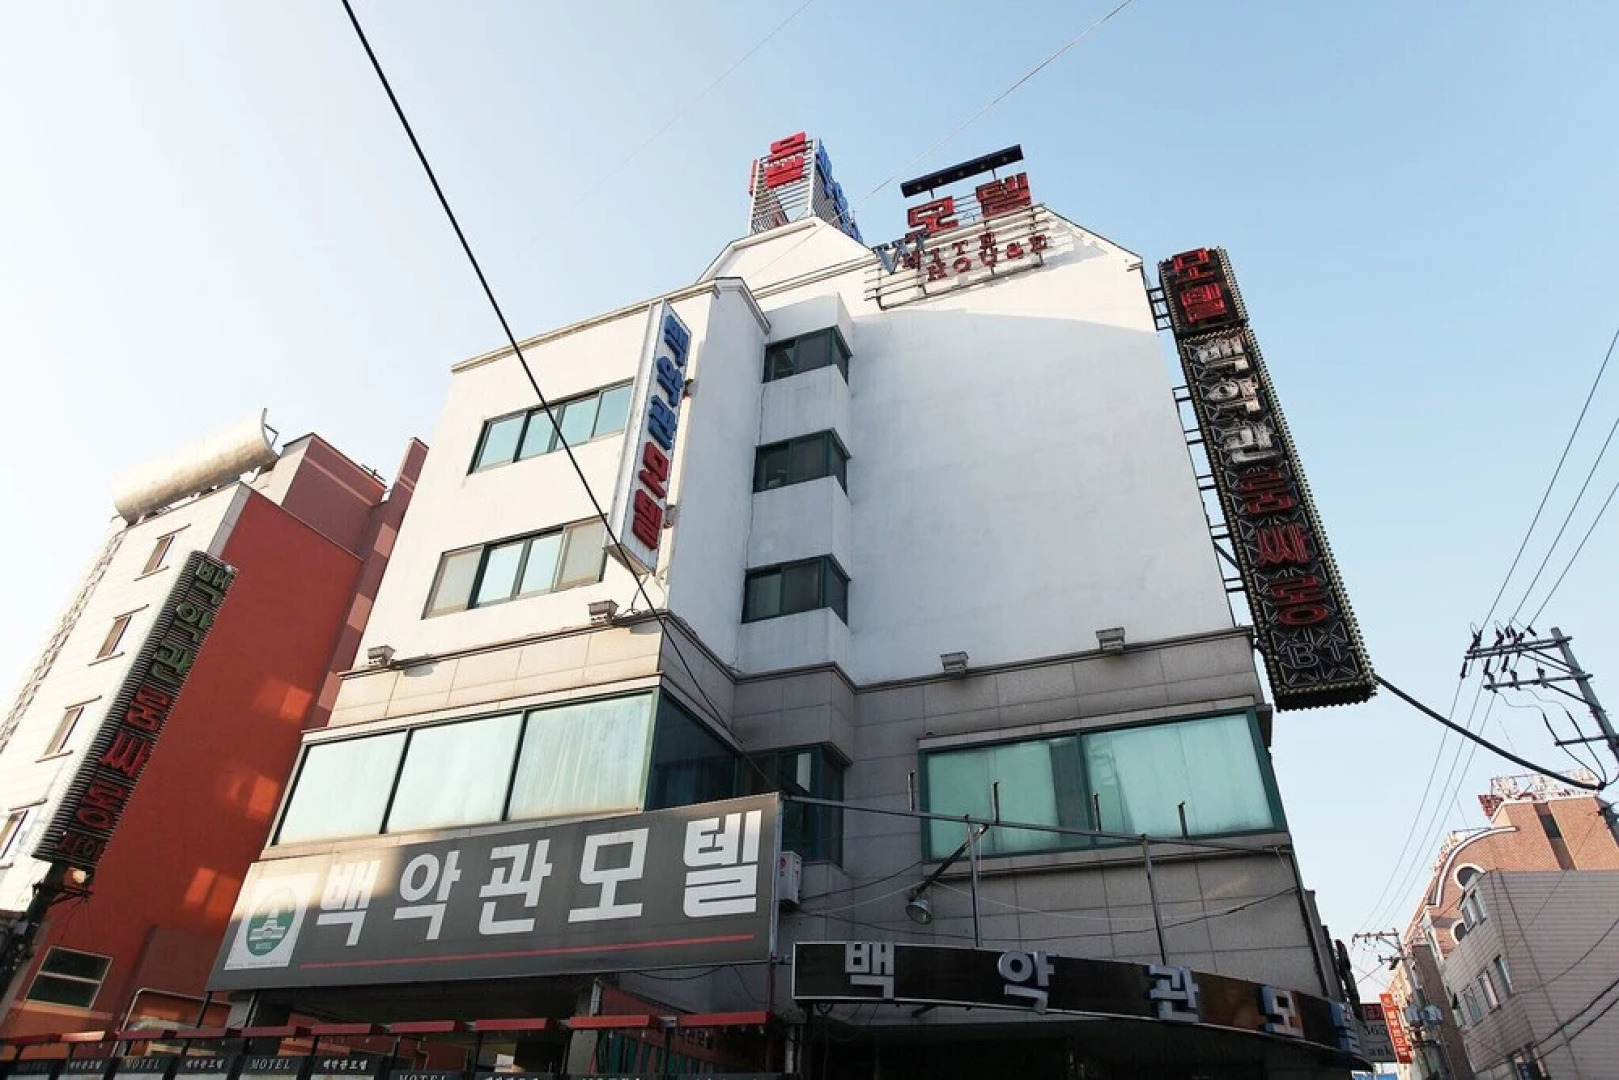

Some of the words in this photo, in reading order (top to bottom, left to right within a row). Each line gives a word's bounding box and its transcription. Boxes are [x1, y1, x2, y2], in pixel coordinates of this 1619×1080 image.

[907, 172, 1032, 235] 모텔
[1170, 247, 1227, 323] 모텔
[1196, 334, 1276, 465] 백악관
[632, 441, 670, 551] 모텔
[250, 1058, 292, 1070] MOTEL
